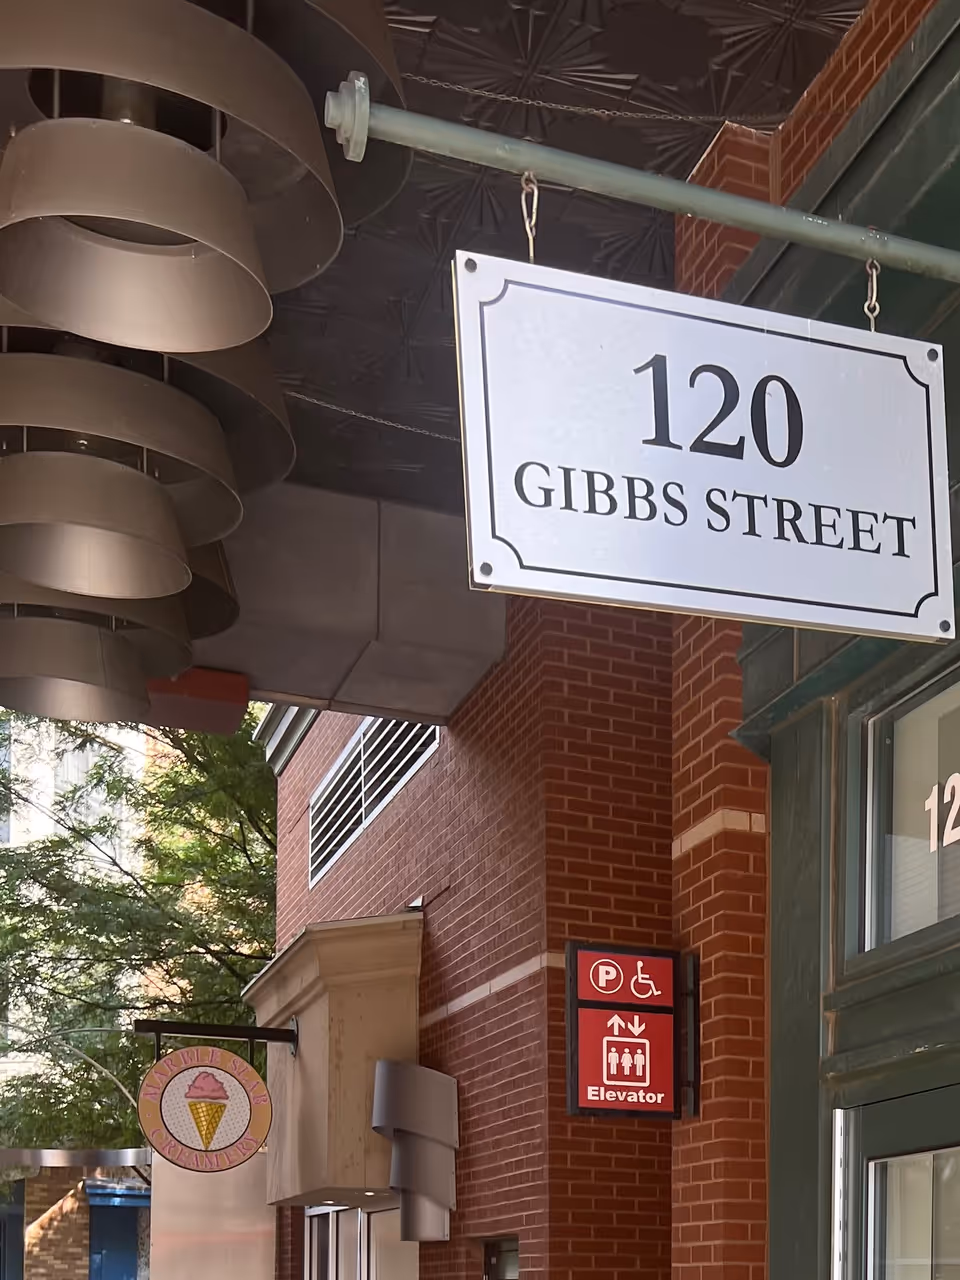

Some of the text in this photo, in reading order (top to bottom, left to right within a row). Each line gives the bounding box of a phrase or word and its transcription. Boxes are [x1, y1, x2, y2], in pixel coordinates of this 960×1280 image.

[633, 354, 803, 469] 120
[514, 461, 916, 558] GIBBS STREET
[143, 1048, 268, 1105] MARBLE SLAB
[587, 1085, 665, 1104] Elevator
[150, 1128, 258, 1169] CREAMERY
